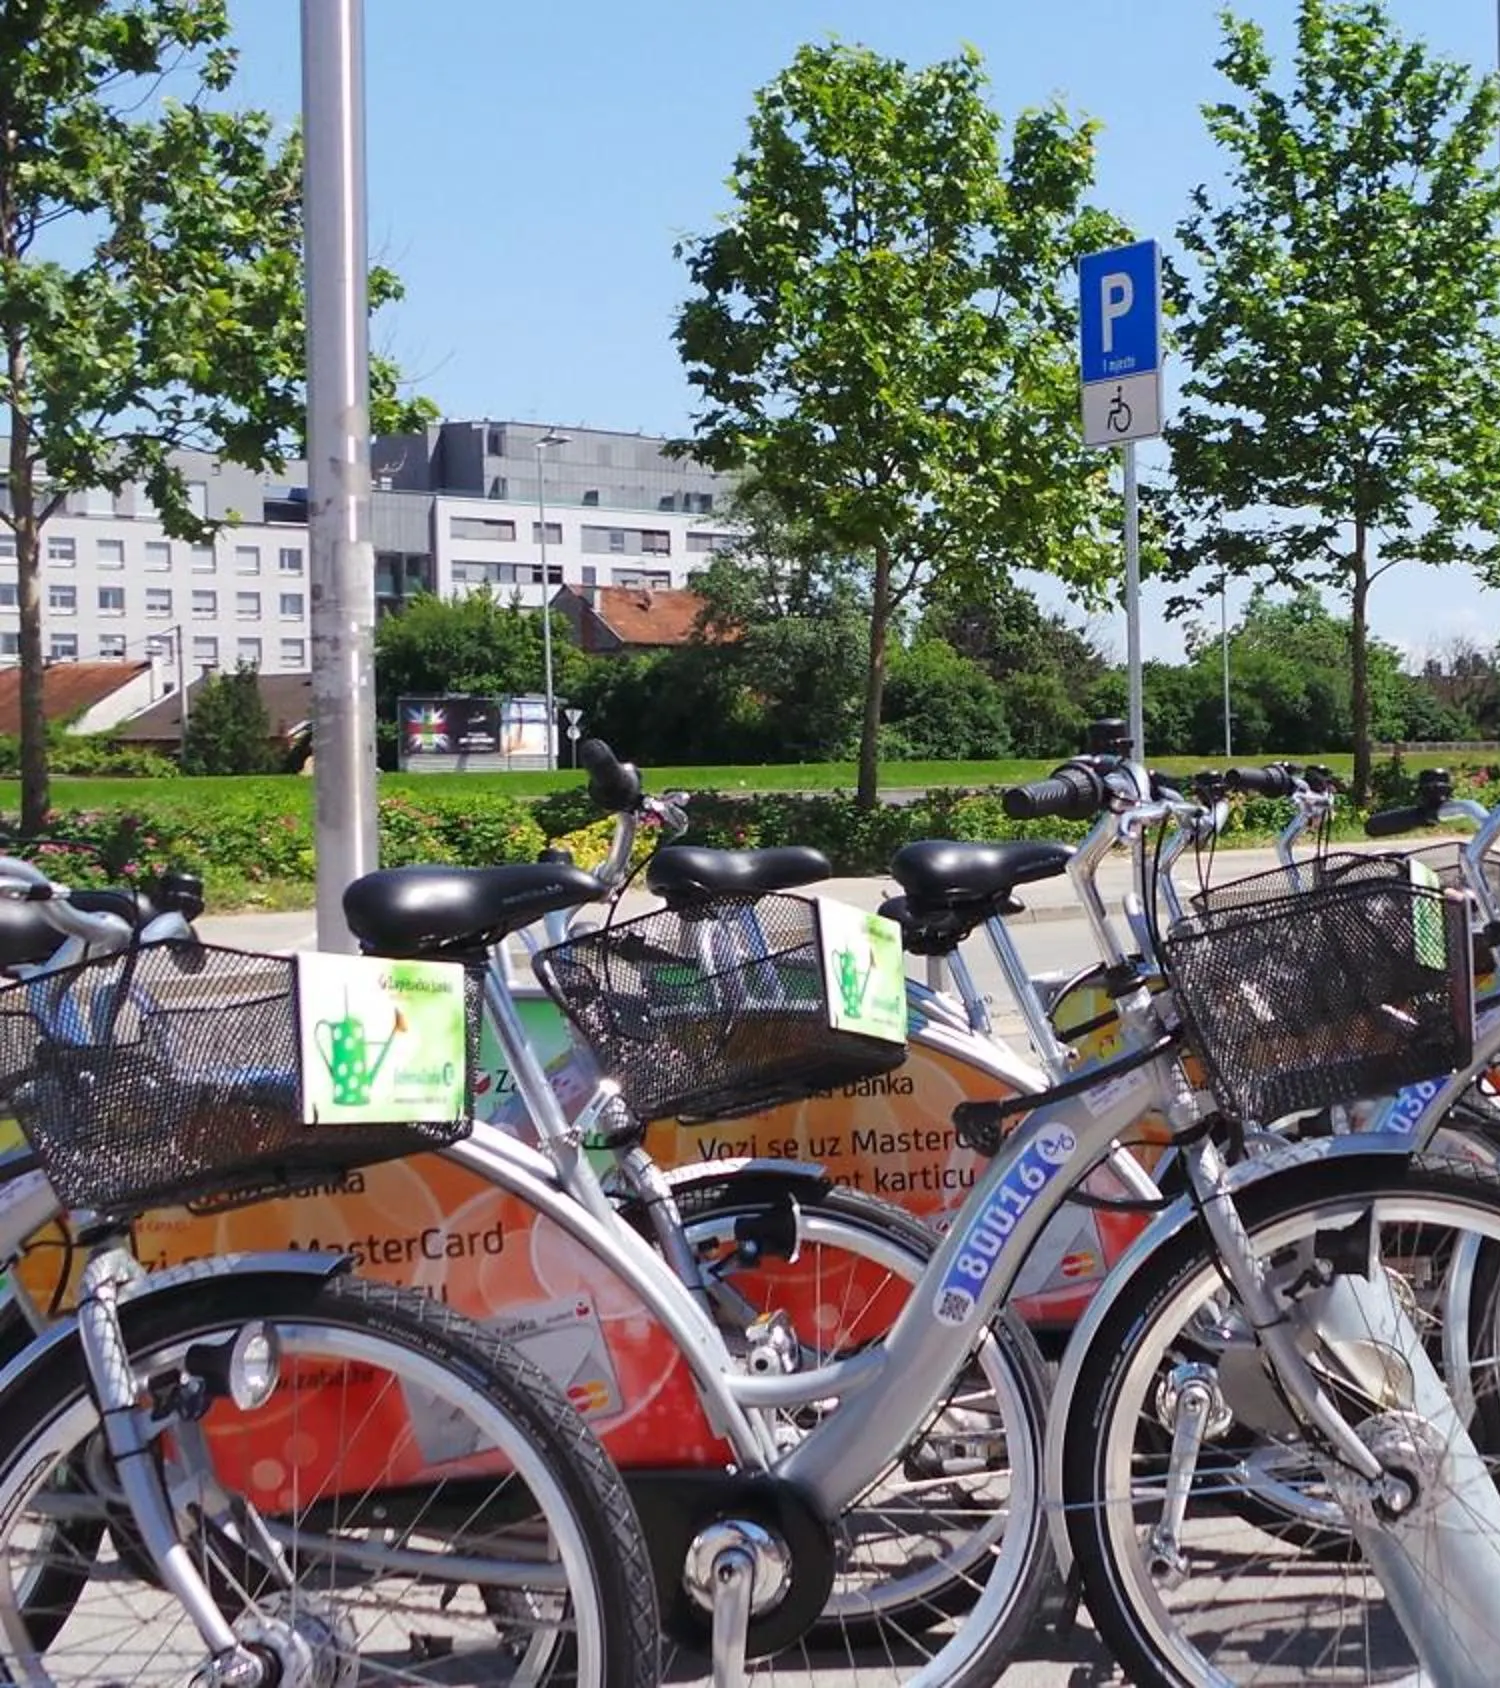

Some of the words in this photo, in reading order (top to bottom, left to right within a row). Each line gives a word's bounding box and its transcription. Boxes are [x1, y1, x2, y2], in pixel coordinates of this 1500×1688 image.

[1101, 271, 1134, 353] P
[697, 1134, 757, 1161] Vozi
[767, 1137, 799, 1158] se
[809, 1135, 842, 1158] uz
[873, 1163, 975, 1193] karticu
